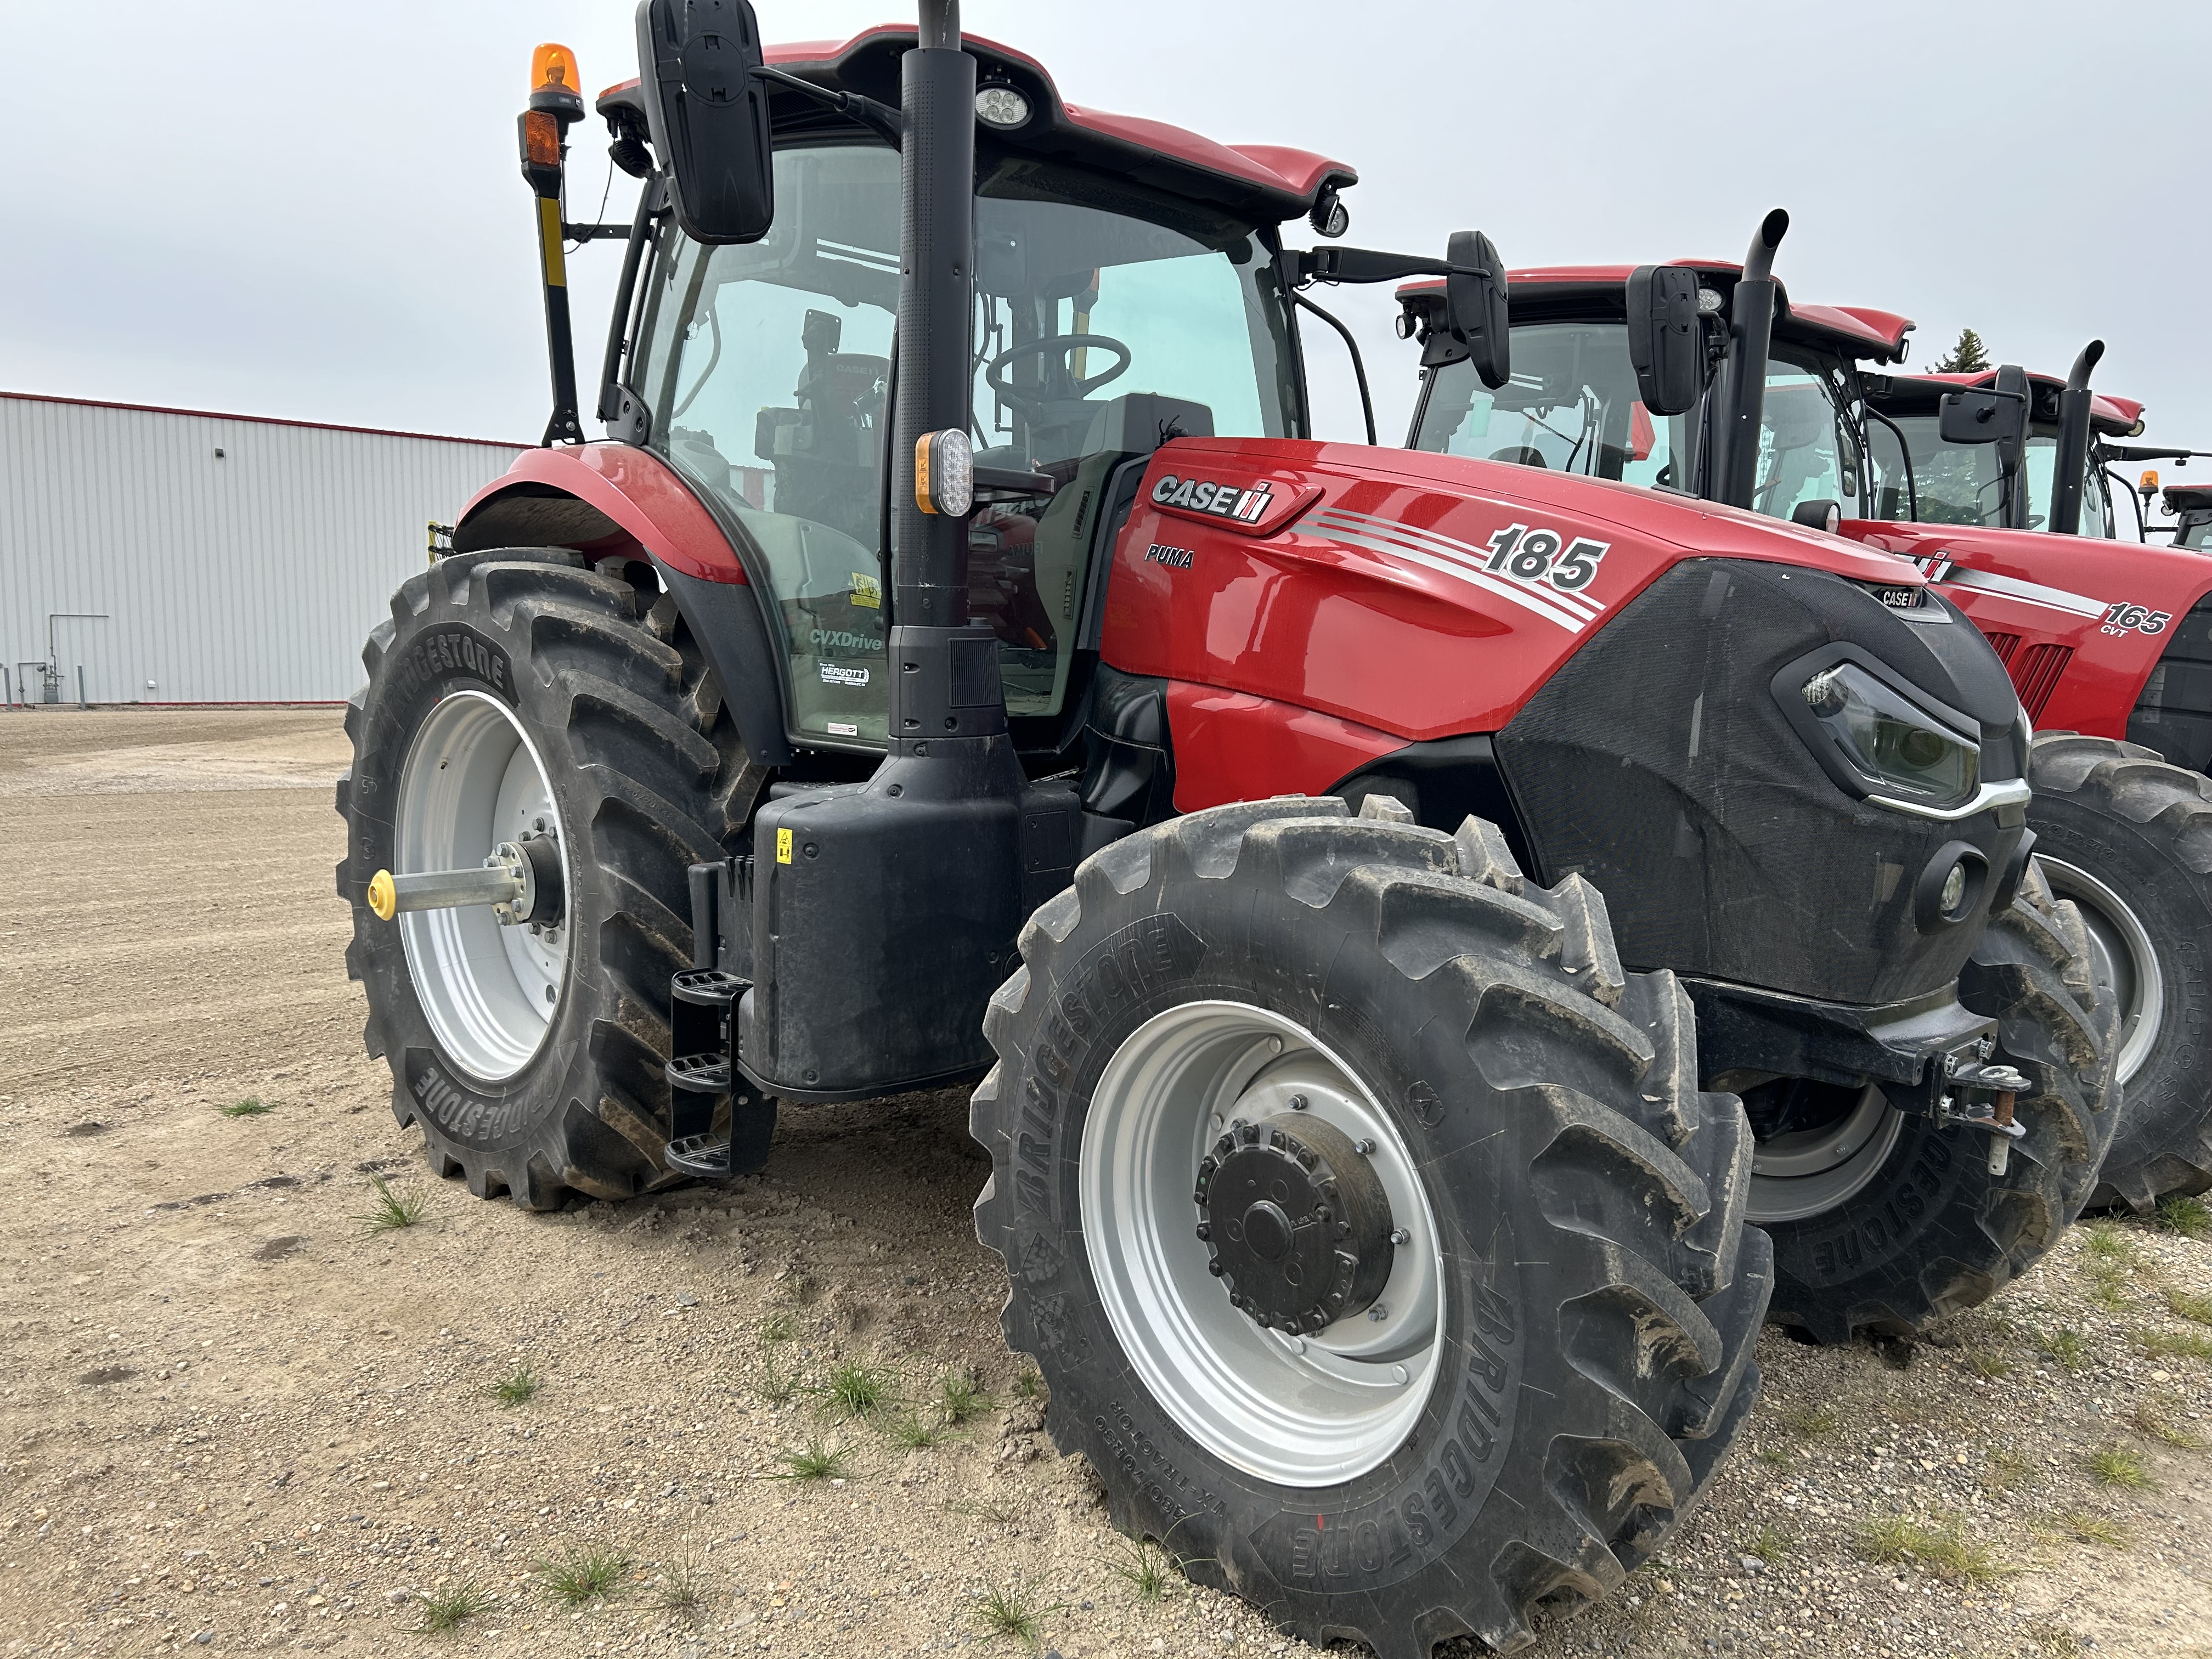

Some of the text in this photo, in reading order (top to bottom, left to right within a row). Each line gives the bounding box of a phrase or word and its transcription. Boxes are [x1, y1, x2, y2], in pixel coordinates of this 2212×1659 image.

[836, 364, 868, 375] CASE
[1152, 475, 1240, 515] CASE
[1144, 544, 1195, 569] PUMA
[1481, 522, 1611, 592] 185
[1883, 590, 1909, 606] CASE
[2101, 625, 2129, 638] CVT
[2105, 601, 2172, 635] 165
[809, 629, 882, 650] CVXDrive
[821, 667, 864, 678] HERGOTT
[1016, 927, 1172, 1219] BRIDGESTONE
[1814, 1123, 1961, 1277] GESTONE
[1293, 1277, 1515, 1578] BRIDGESTONE
[1094, 1415, 1186, 1520] 480/70R30
[1109, 1401, 1227, 1519] VX-TRACTOR
